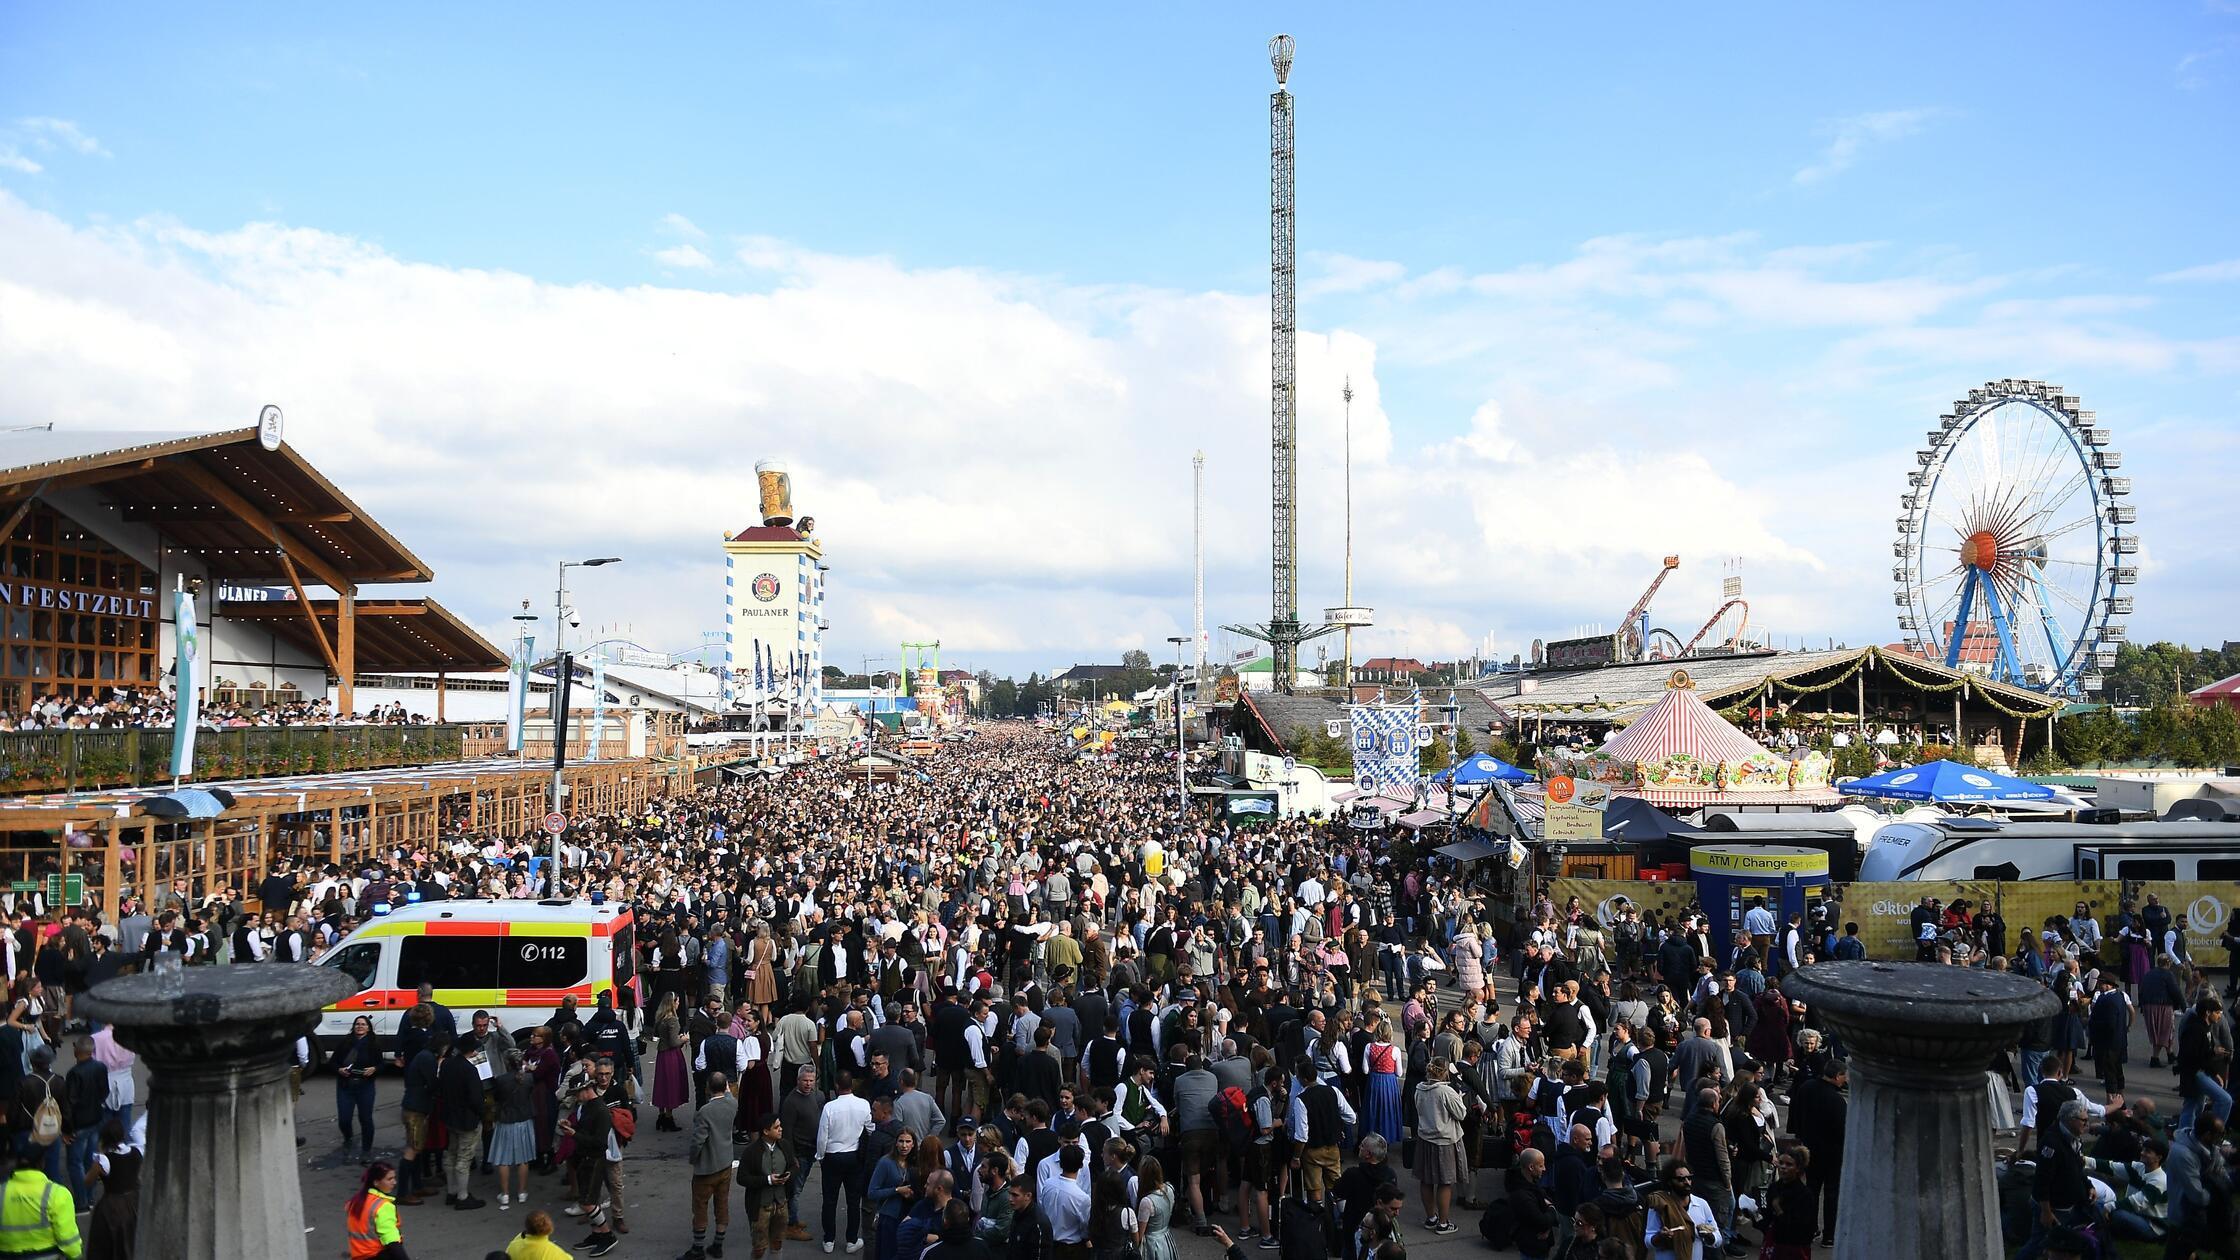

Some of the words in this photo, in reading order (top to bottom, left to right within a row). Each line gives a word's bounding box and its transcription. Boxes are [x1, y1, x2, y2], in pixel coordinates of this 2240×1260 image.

[21, 585, 153, 619] FESTZELT
[742, 608, 789, 617] PAULANER
[1554, 781, 1567, 790] OX
[1709, 855, 1730, 866] ATM
[1734, 857, 1739, 869] /
[1742, 857, 1788, 870] Change
[541, 946, 566, 960] 112
